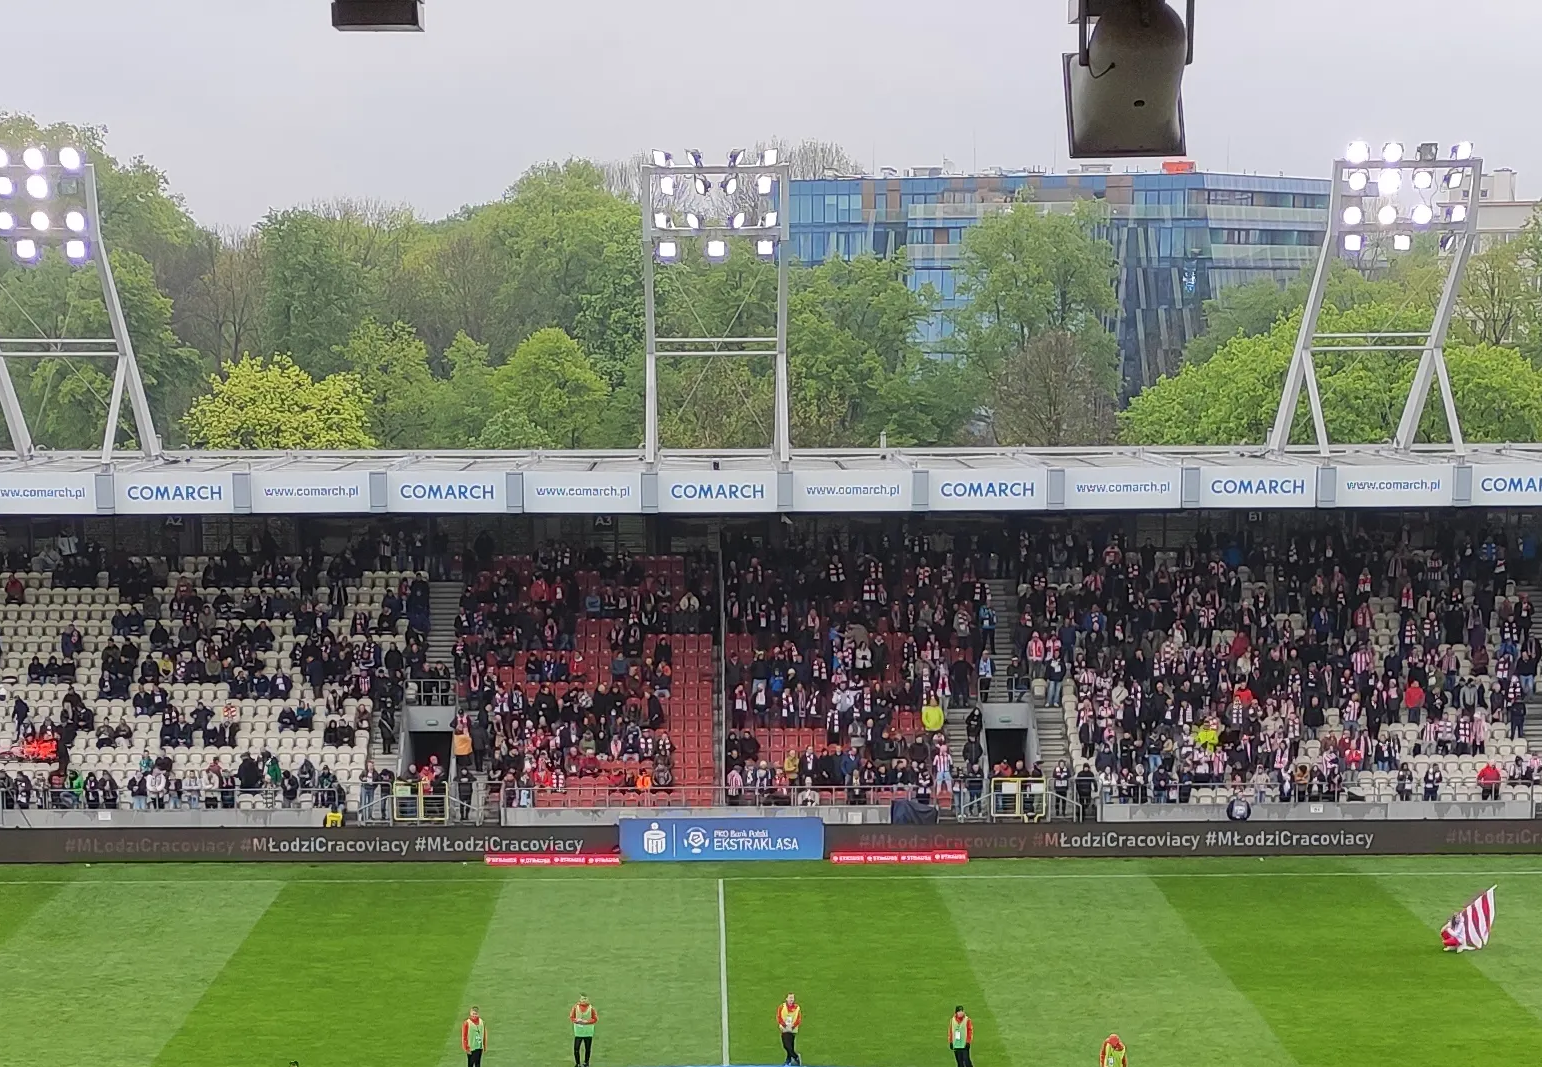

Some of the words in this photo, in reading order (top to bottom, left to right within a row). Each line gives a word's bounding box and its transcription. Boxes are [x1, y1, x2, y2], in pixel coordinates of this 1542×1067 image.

[264, 485, 360, 499] www.comarch.pl
[400, 485, 495, 499] COMARCH
[536, 486, 631, 499] www.comarch.pl
[671, 485, 765, 498] COMARCH
[806, 484, 900, 498] www.comarch.pl
[941, 483, 1036, 497] COMARCH
[1076, 482, 1171, 495] www.comarch.pl
[1211, 480, 1306, 494] COMARCH
[1346, 479, 1441, 492] www.comarch.pl
[127, 486, 223, 500] COMARCH
[65, 837, 236, 857] #MŁodziCracoviacy
[240, 837, 410, 857] #MŁodziCracoviacy
[415, 835, 584, 857] #MŁodziCracoviacy
[713, 837, 800, 852] EKSTRAKLASA
[1033, 831, 1201, 851] #MŁodziCracoviacy
[1205, 829, 1374, 849] #MŁodziCracoviacy
